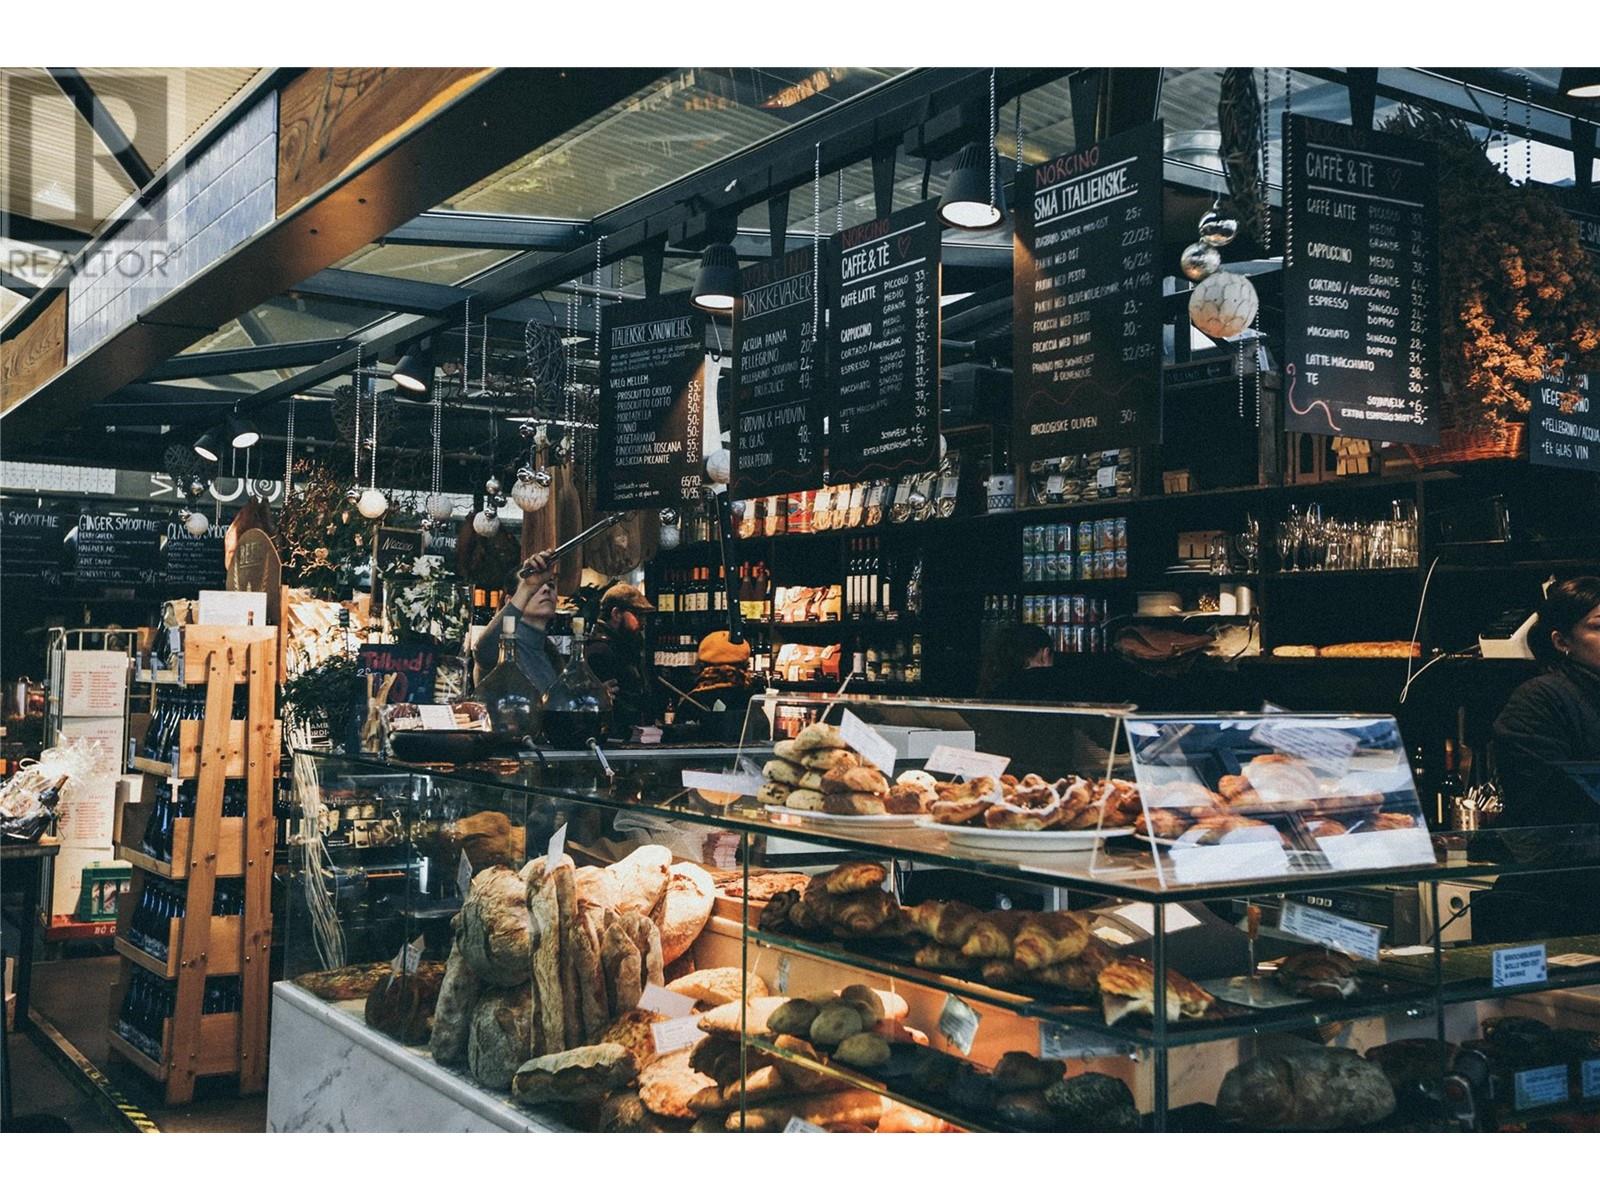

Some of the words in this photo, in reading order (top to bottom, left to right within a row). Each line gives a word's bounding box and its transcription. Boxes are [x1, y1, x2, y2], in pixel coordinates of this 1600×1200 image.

[1036, 145, 1100, 188] NORCINO
[1347, 160, 1357, 185] &
[1034, 189, 1058, 221] SMÅ
[1333, 201, 1357, 221] LATTE
[1369, 223, 1396, 237] MEDIO
[1369, 238, 1399, 251] GRANDE
[868, 249, 877, 272] &
[1307, 241, 1353, 264] CAPPUCCINO
[1369, 255, 1395, 270] MEDIO
[1067, 268, 1086, 284] PESTO
[1368, 273, 1400, 288] GRANDE
[742, 274, 813, 319] DRIKKEVARER
[858, 285, 876, 304] LATTE
[884, 275, 909, 291] PICCOLO
[883, 289, 905, 303] MEDIO
[1308, 278, 1342, 293] CORTADO
[1343, 281, 1349, 295] /
[1349, 284, 1391, 299] AMERICANO
[883, 300, 906, 315] GRANDE
[1308, 295, 1349, 310] ESPRESSO
[1367, 302, 1399, 316] SINGOLO
[1033, 318, 1058, 333] FOCACCIA
[1073, 310, 1091, 325] PESTO
[1367, 315, 1395, 328] DOPPIO
[612, 326, 646, 348] ITALIENSKE
[647, 318, 692, 341] SANDWICHES
[840, 322, 872, 343] CAPPUCCINO
[1307, 326, 1350, 340] MACCHIATO
[1366, 332, 1397, 345] SINGOLO
[742, 336, 763, 353] ACQUA
[765, 329, 788, 347] PANNA
[1032, 338, 1057, 354] FOCACCIA
[1073, 332, 1092, 346] TOMAT
[741, 347, 780, 370] PELLEGRINO
[840, 344, 868, 360] CORTADO
[1366, 346, 1393, 358] DOPPIO
[840, 359, 871, 375] ESPRESSO
[1305, 353, 1330, 366] LATTE
[1331, 356, 1375, 372] MACCHIATO
[626, 375, 649, 387] MELLEM
[840, 380, 871, 396] MACCHIATO
[651, 385, 672, 396] CRUDO
[651, 396, 672, 408] COTTO
[767, 410, 773, 428] &
[774, 406, 806, 426] HVIDVIN
[1341, 408, 1365, 419] EXTRA
[1031, 419, 1069, 435] ØKOLOGISKE
[1071, 416, 1098, 431] OLIVEN
[616, 432, 656, 444] VEGETARIANO
[653, 441, 682, 454] TOSCANA
[1555, 442, 1573, 458] GLAS
[1574, 445, 1589, 460] VIN
[643, 454, 670, 464] PICCANTE
[8, 511, 59, 528] SMOOTHIE
[79, 514, 114, 531] GINGER
[115, 517, 160, 532] SMOOTHIE
